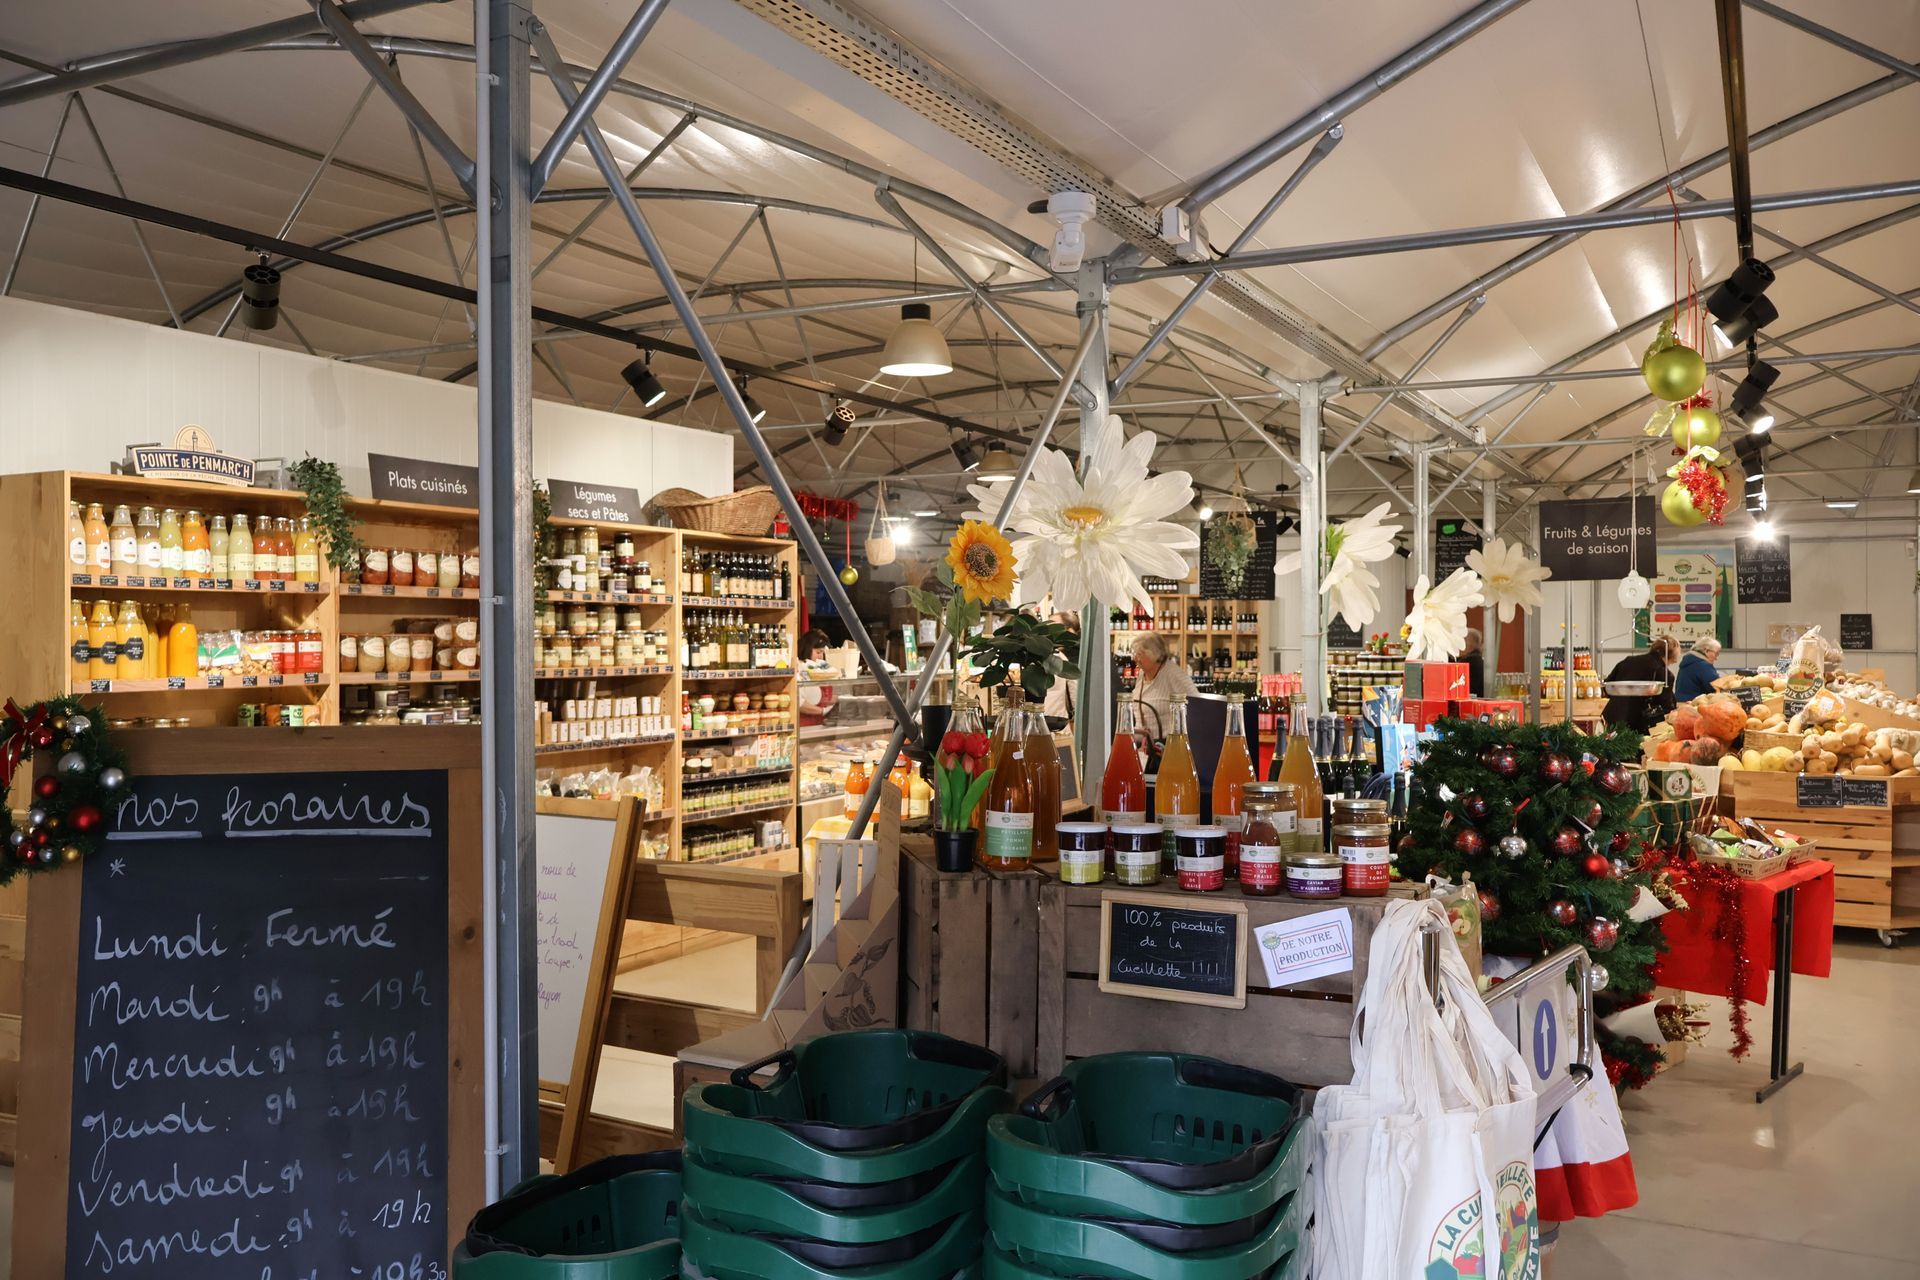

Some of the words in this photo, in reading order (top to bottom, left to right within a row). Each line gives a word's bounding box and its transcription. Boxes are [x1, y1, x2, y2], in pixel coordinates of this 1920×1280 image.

[140, 453, 180, 468] POINTE
[192, 455, 250, 479] PENMARC'H
[388, 470, 418, 490] Plats
[420, 476, 468, 495] cuisinés
[574, 485, 617, 504] Légumes
[568, 507, 590, 519] secs
[591, 507, 601, 520] et
[602, 506, 629, 522] Pâtes
[1544, 526, 1577, 539] Fruits
[1581, 525, 1592, 538] &
[1596, 524, 1652, 540] Légumes
[1567, 541, 1584, 555] de
[1588, 542, 1629, 554] saison
[117, 793, 199, 830] nos
[222, 783, 431, 829] horaires
[266, 906, 397, 948] Fermé
[1124, 908, 1162, 928] 100%
[1171, 919, 1227, 934] produits
[1139, 935, 1158, 948] de
[1281, 939, 1296, 951] DE
[1297, 930, 1333, 947] NOTRE
[1279, 942, 1344, 966] PRODUCTION
[1117, 958, 1187, 980] Cueillette
[325, 1031, 349, 1068] à
[359, 1030, 426, 1070] 19h
[372, 1143, 434, 1179] 19h
[372, 1189, 432, 1229] 19h
[1437, 1224, 1462, 1251] LA
